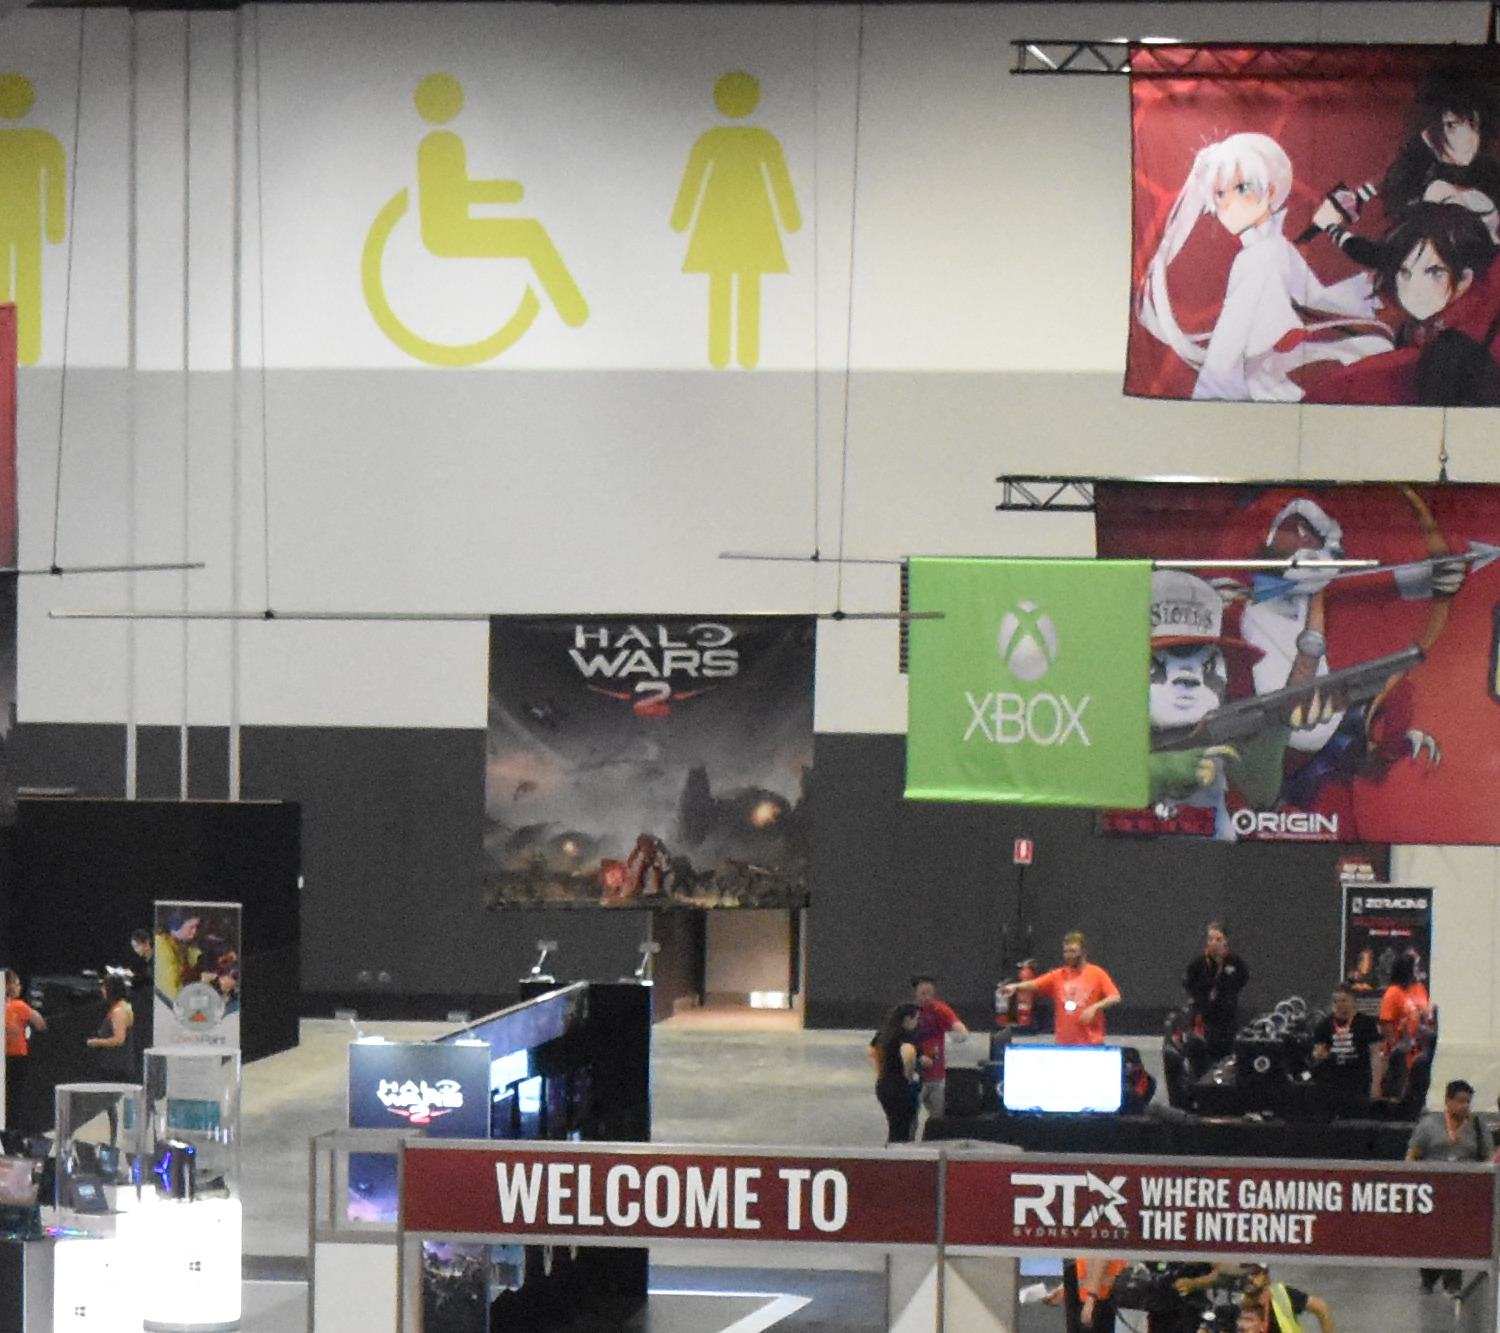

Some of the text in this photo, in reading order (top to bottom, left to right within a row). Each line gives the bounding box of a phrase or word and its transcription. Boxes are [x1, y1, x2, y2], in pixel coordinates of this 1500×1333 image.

[574, 622, 734, 648] HALO
[568, 648, 739, 678] WARS
[632, 680, 671, 716] 2
[964, 691, 1092, 748] XBOX
[1231, 809, 1339, 835] ORIGIN
[378, 1078, 463, 1097] HALO
[495, 1161, 849, 1233] WELCOME TO
[1010, 1170, 1129, 1229] RTX
[1140, 1175, 1434, 1214] WHERE GAMING MEETS
[1013, 1227, 1081, 1239] SYDNEY
[1139, 1210, 1318, 1245] THE INTERNET
